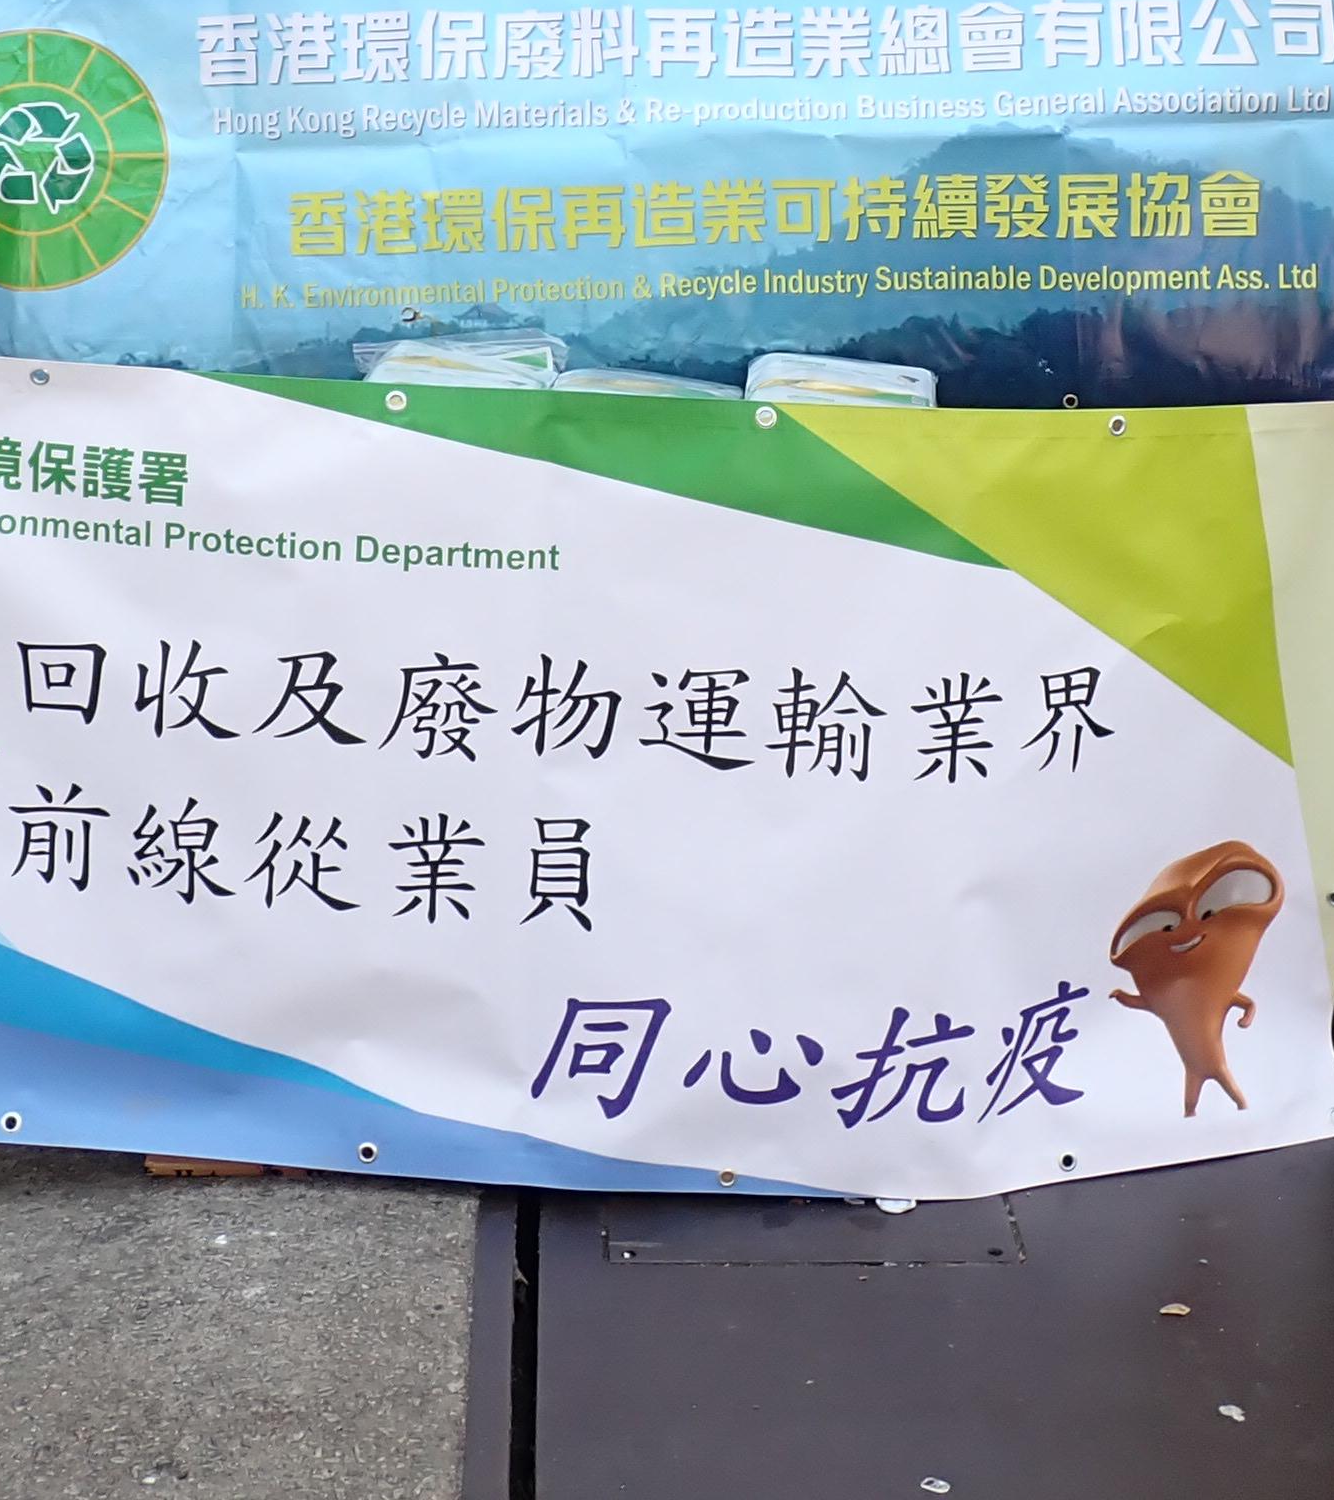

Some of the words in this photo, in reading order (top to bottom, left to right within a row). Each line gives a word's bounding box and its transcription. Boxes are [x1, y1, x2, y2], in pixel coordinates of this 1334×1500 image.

[213, 106, 281, 139] Hong
[288, 104, 357, 138] Kong
[362, 100, 466, 137] Recycle
[474, 98, 609, 129] Materials
[616, 98, 636, 125] &
[646, 96, 847, 126] Re-production
[857, 94, 986, 120] Business
[994, 87, 1105, 117] General
[1113, 85, 1279, 115] Association
[1287, 84, 1331, 113] Ltd
[289, 170, 1262, 257] 香港環保再造業可持續發展協會
[240, 284, 262, 308] H.
[272, 284, 295, 309] K.
[304, 277, 485, 308] Environmental
[492, 274, 625, 303] Protection
[632, 274, 653, 299] &
[660, 268, 757, 301] Recycle
[763, 268, 868, 298] Industry
[875, 264, 1031, 292] Sustainable
[1039, 264, 1211, 296] Development
[1217, 264, 1269, 290] Ass.
[1278, 263, 1318, 290] Ltd
[165, 522, 343, 562] Protection
[355, 534, 560, 572] Department
[16, 638, 1116, 785] 回收及廢物運輸業界
[9, 783, 595, 932] 前線從業員
[530, 979, 1092, 1129] 同心抗疫
